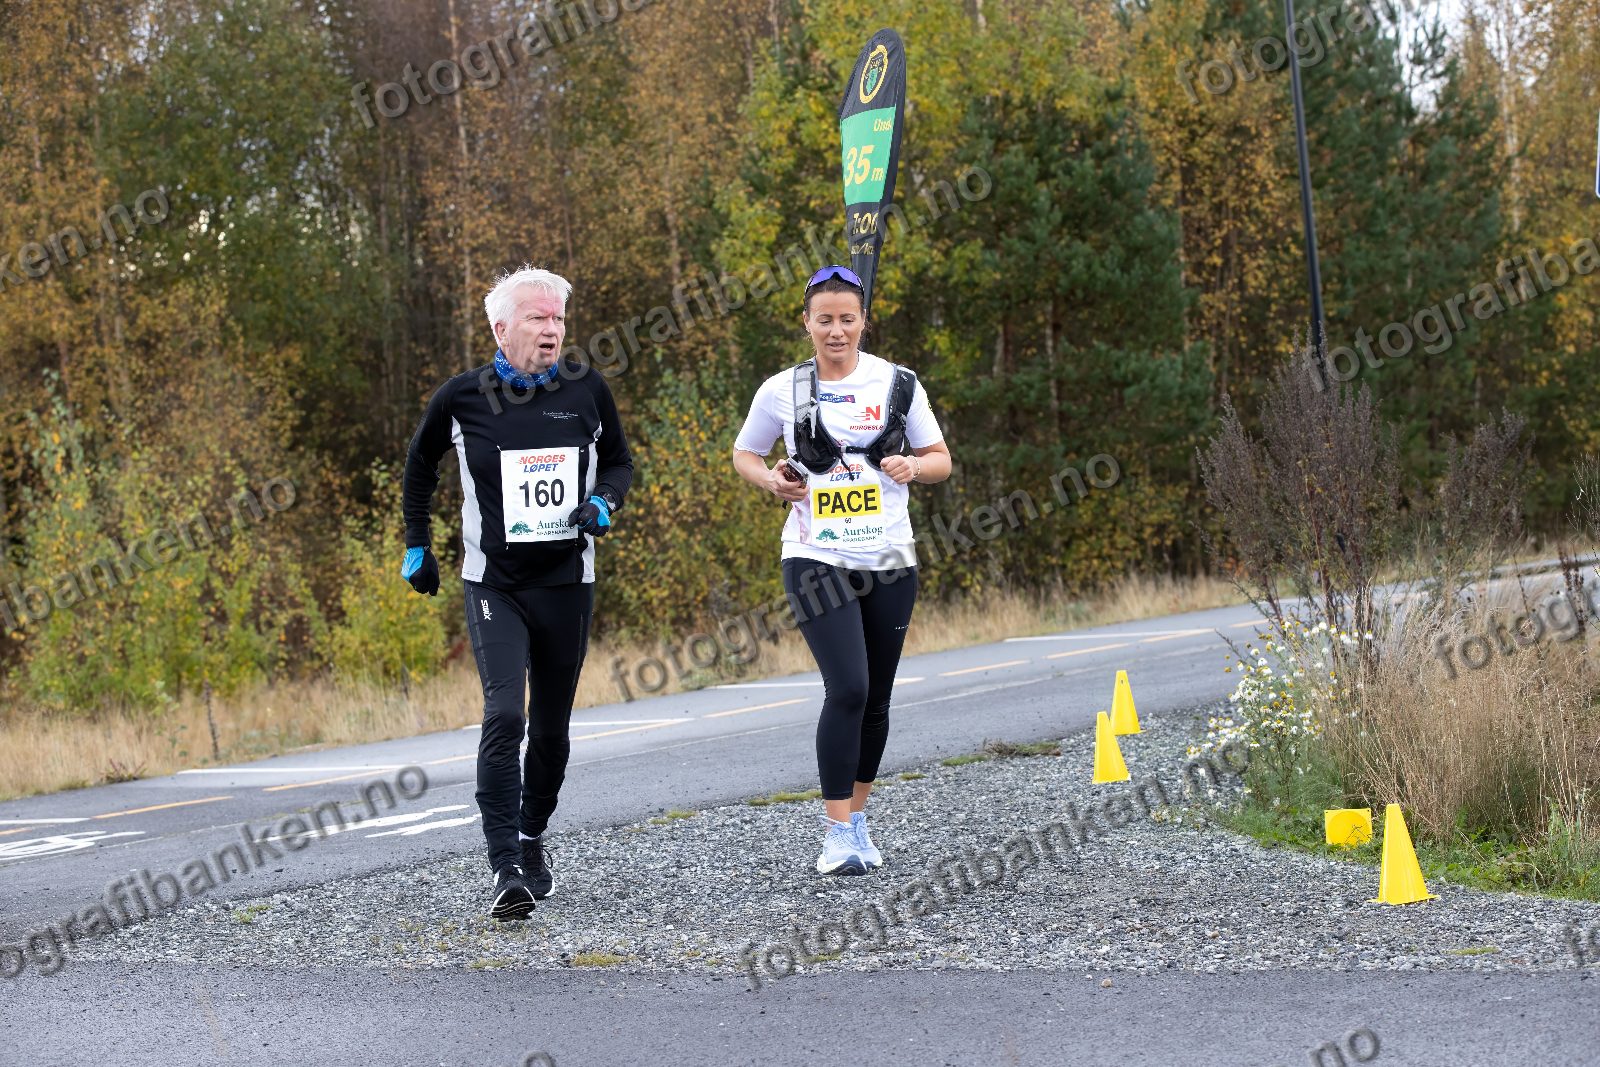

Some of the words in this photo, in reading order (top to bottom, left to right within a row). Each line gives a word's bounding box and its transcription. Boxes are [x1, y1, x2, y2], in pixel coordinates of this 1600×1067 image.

[844, 145, 875, 187] 35
[518, 454, 566, 465] NORGES
[523, 463, 559, 473] LØPET
[518, 478, 565, 508] 160
[817, 489, 878, 515] PACE
[842, 525, 883, 537] Aurskog
